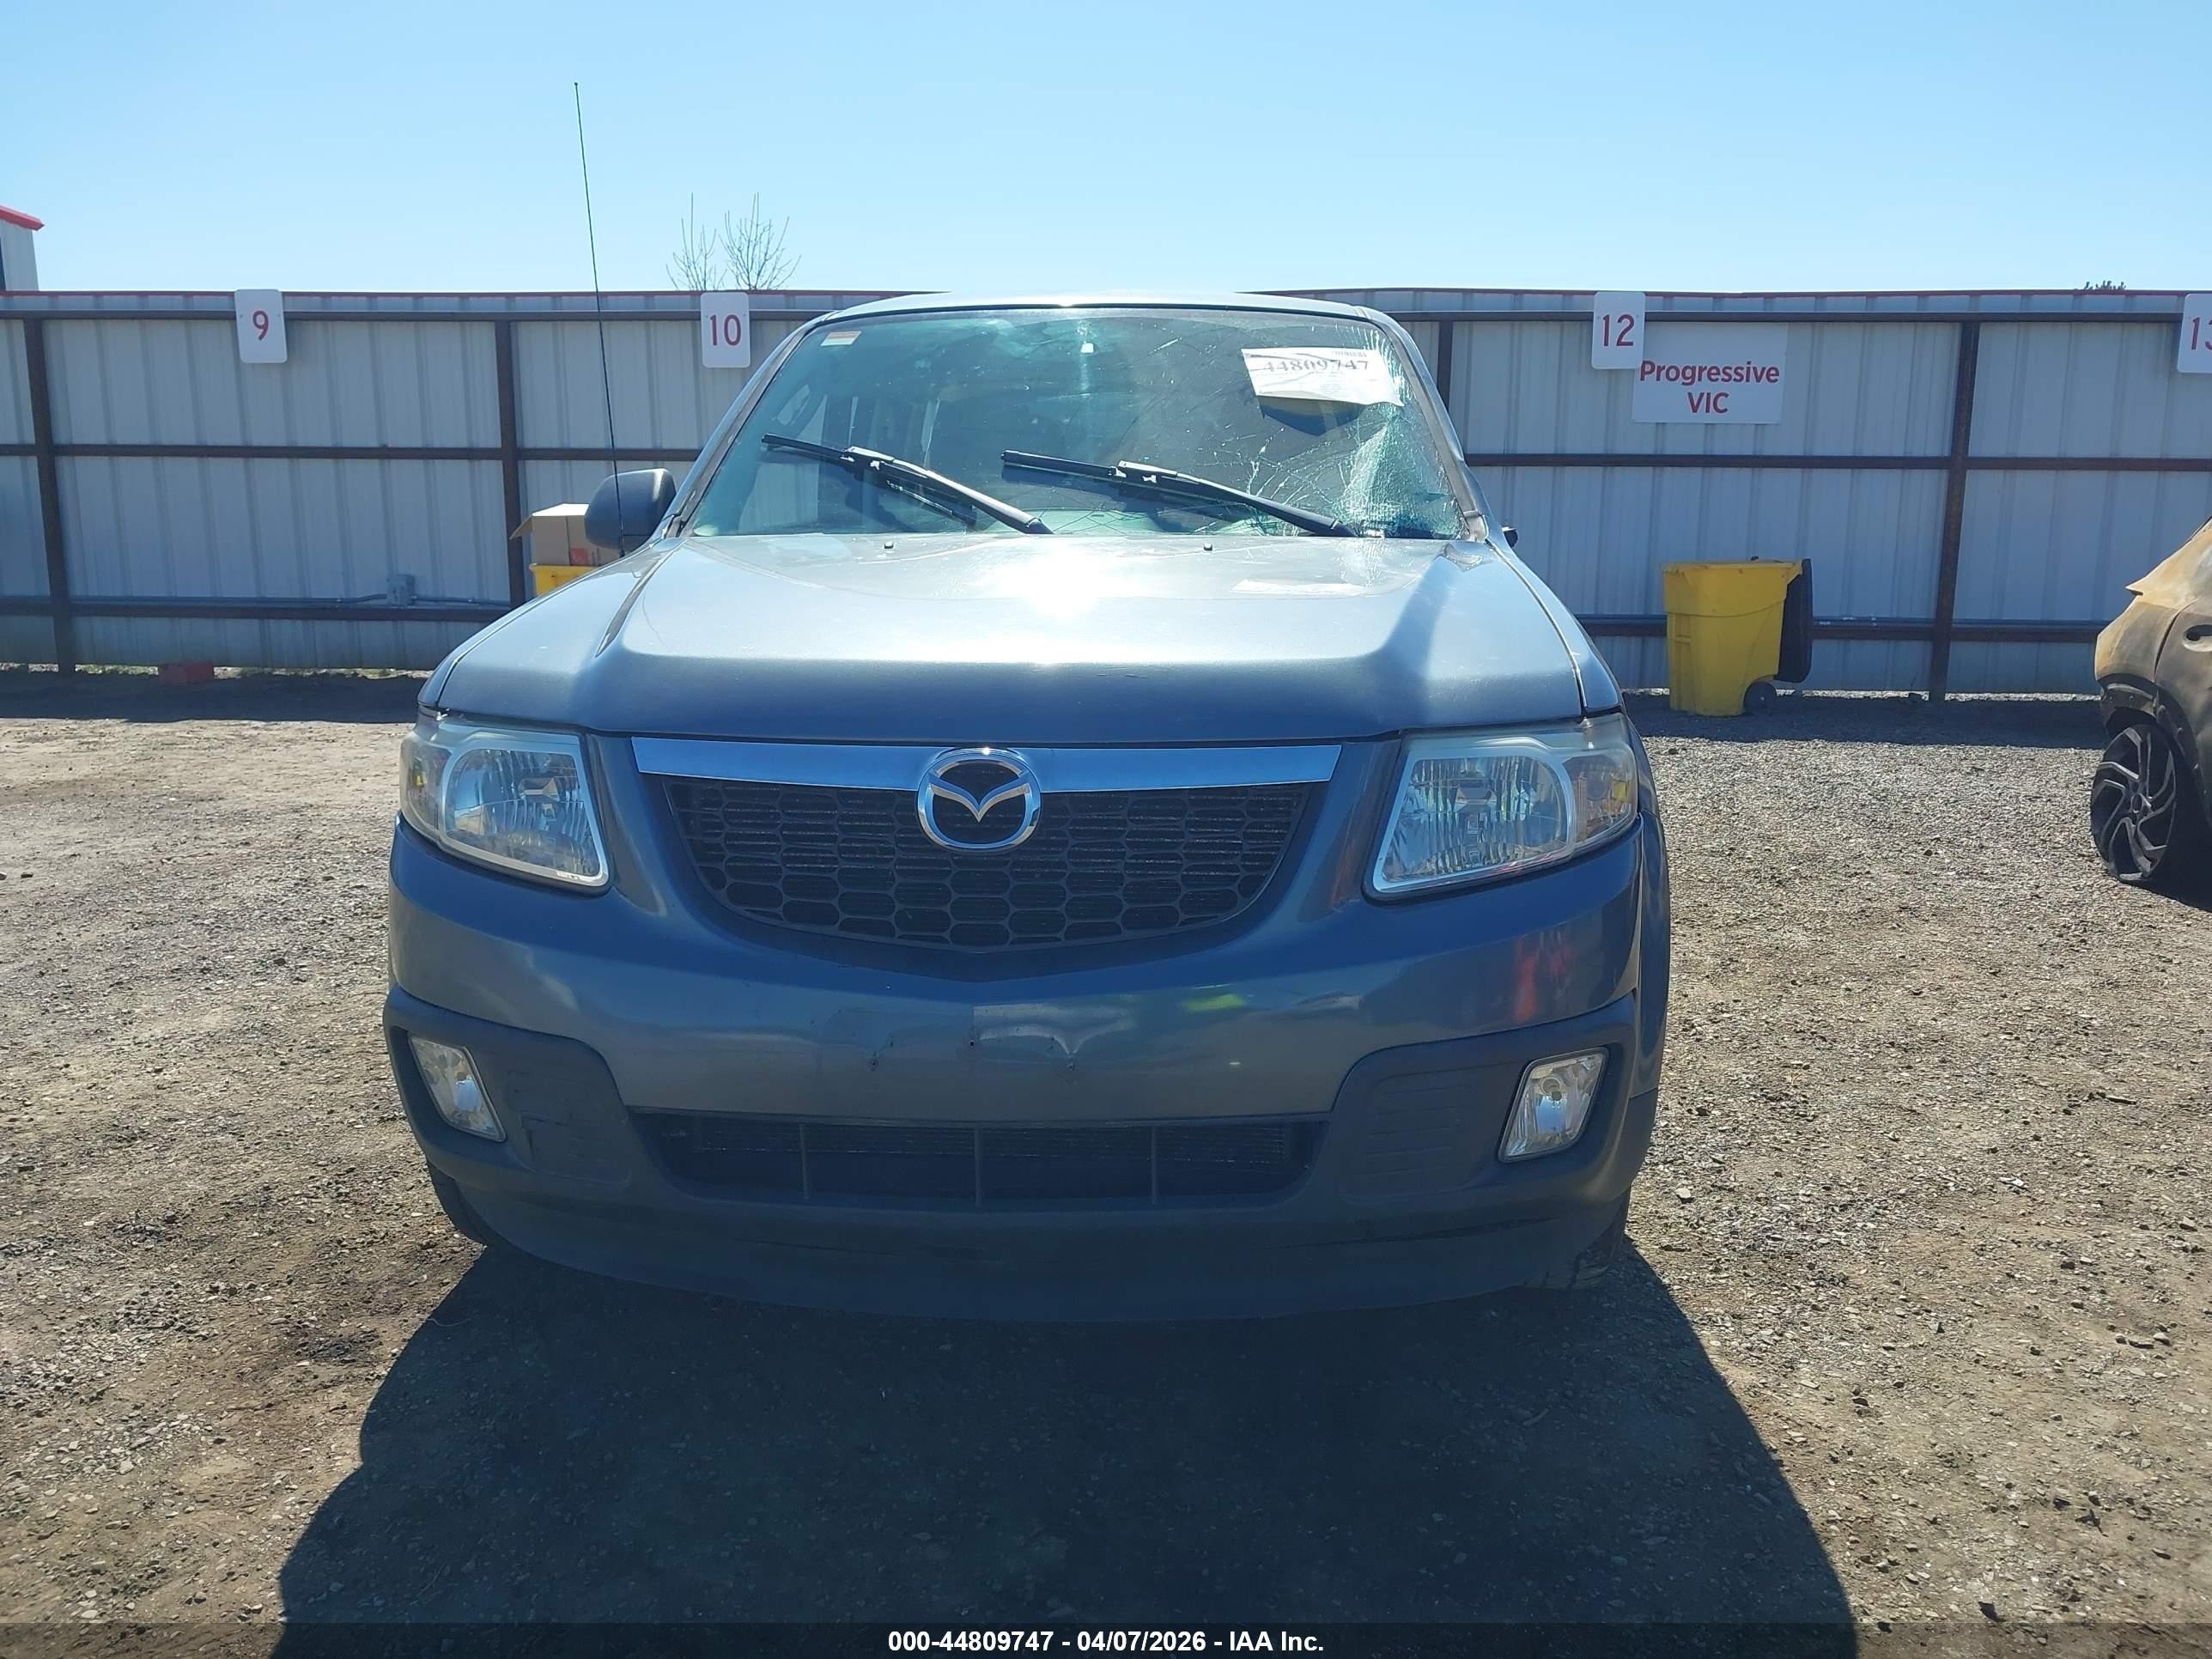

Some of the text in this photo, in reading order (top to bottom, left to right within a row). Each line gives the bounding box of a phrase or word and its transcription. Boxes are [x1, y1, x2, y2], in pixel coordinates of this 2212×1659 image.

[252, 310, 269, 341] 9
[709, 314, 742, 346] 10
[1602, 314, 1635, 347] 12
[1263, 358, 1369, 372] 44809747
[1639, 360, 1780, 386] Progressive
[1687, 392, 1730, 414] VIC
